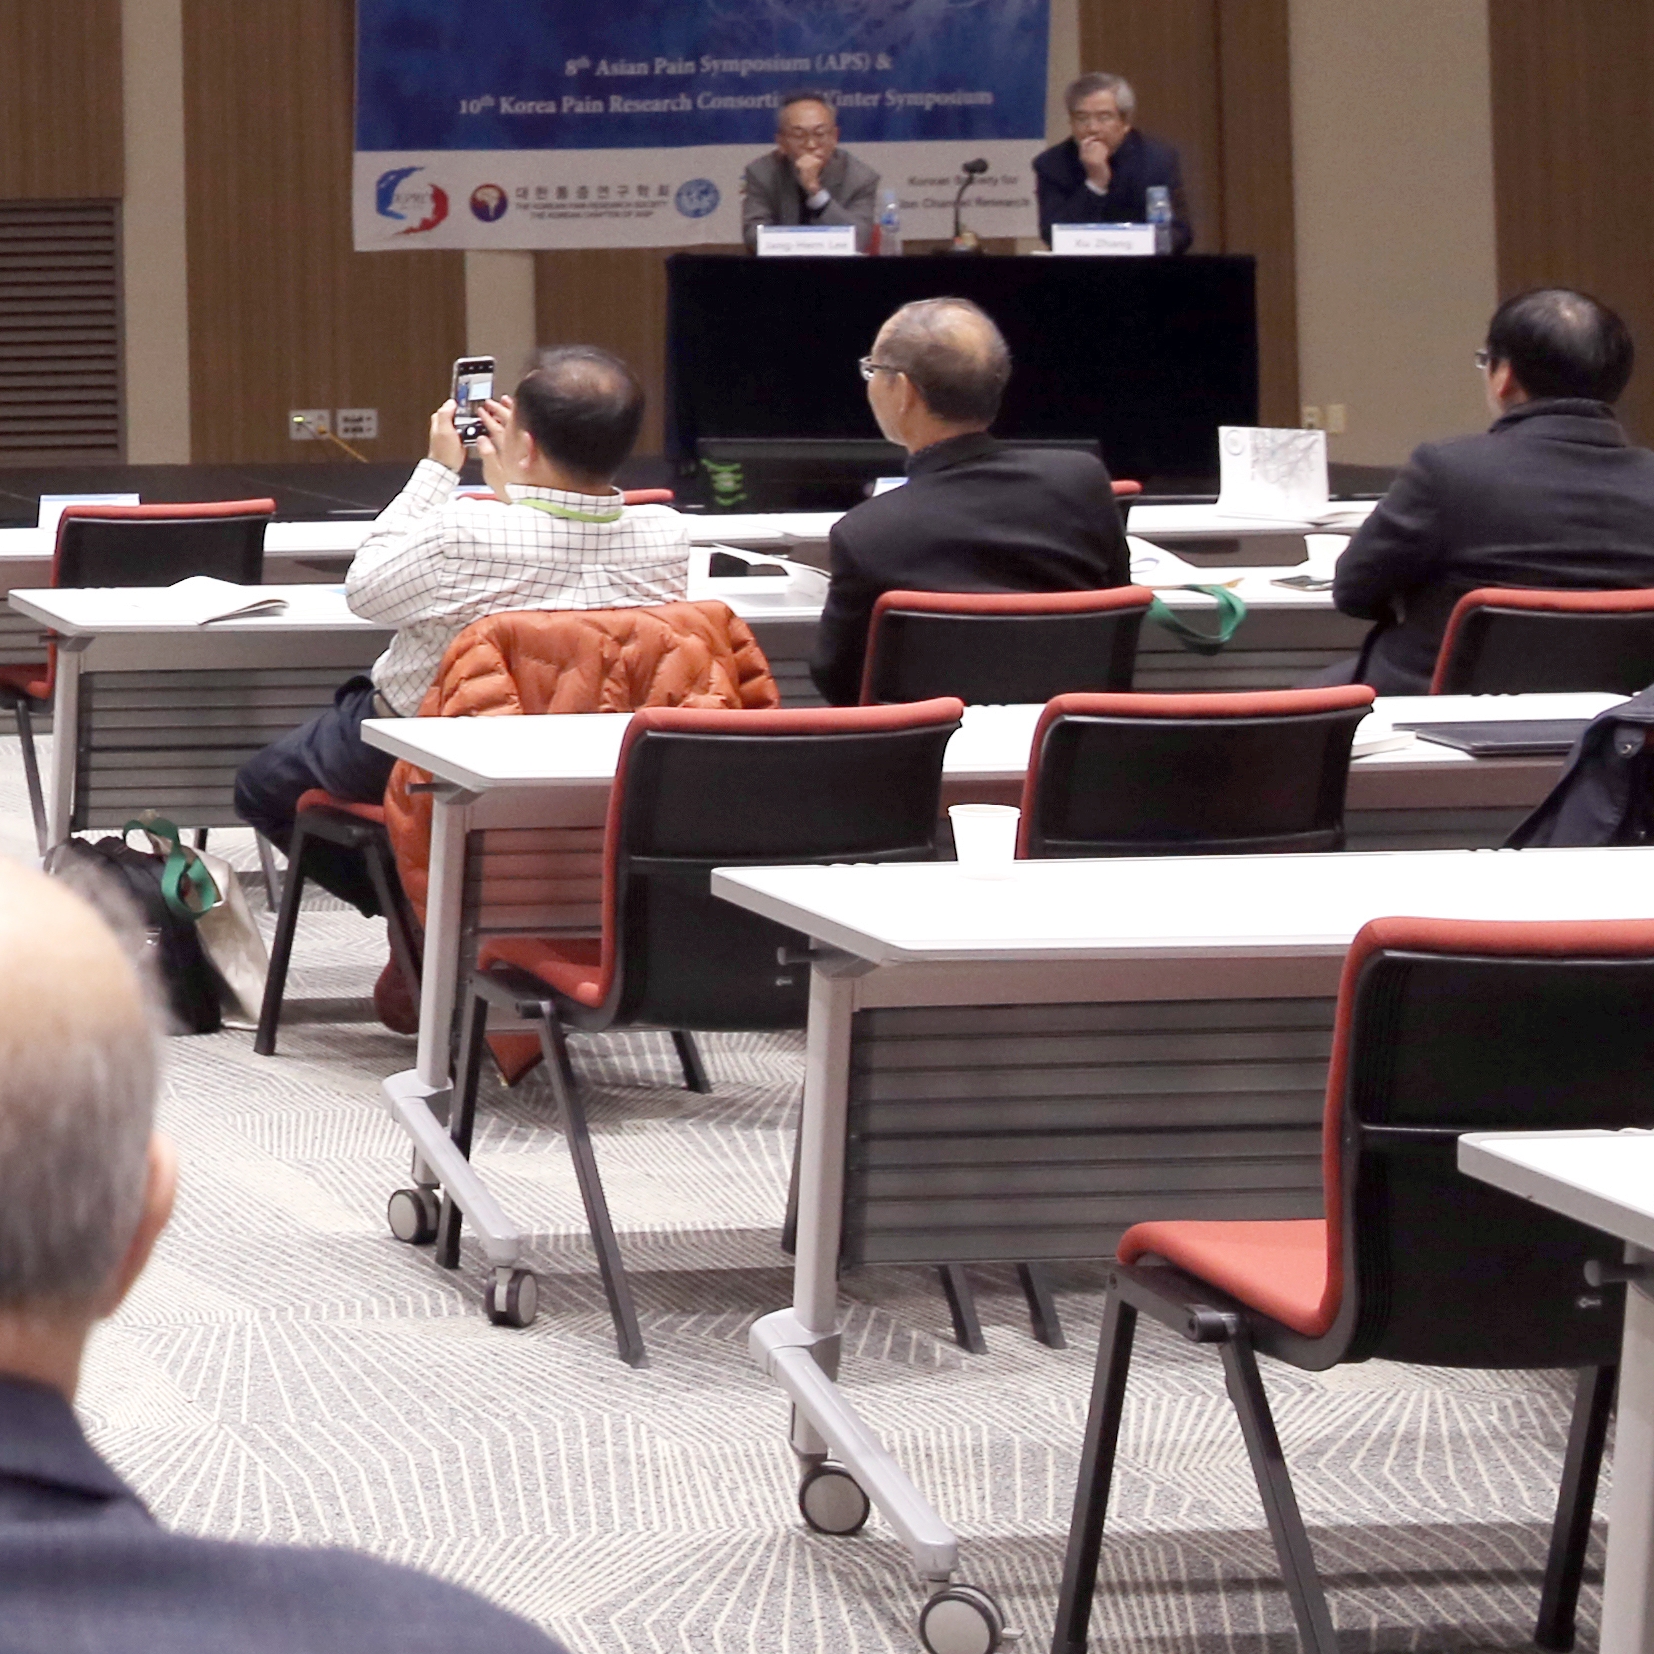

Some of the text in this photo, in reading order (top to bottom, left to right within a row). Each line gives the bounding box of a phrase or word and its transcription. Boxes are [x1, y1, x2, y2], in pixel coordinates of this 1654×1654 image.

[564, 57, 590, 78] 8th
[594, 56, 649, 78] Asian
[654, 55, 695, 77] Pain
[700, 54, 811, 79] Symposium
[815, 53, 870, 77] (APS)
[459, 96, 495, 117] 10th
[500, 94, 556, 115] Korea
[560, 95, 603, 114] Pain
[608, 92, 692, 113] Research
[697, 91, 780, 112] Consorti
[885, 88, 994, 114] Symposium
